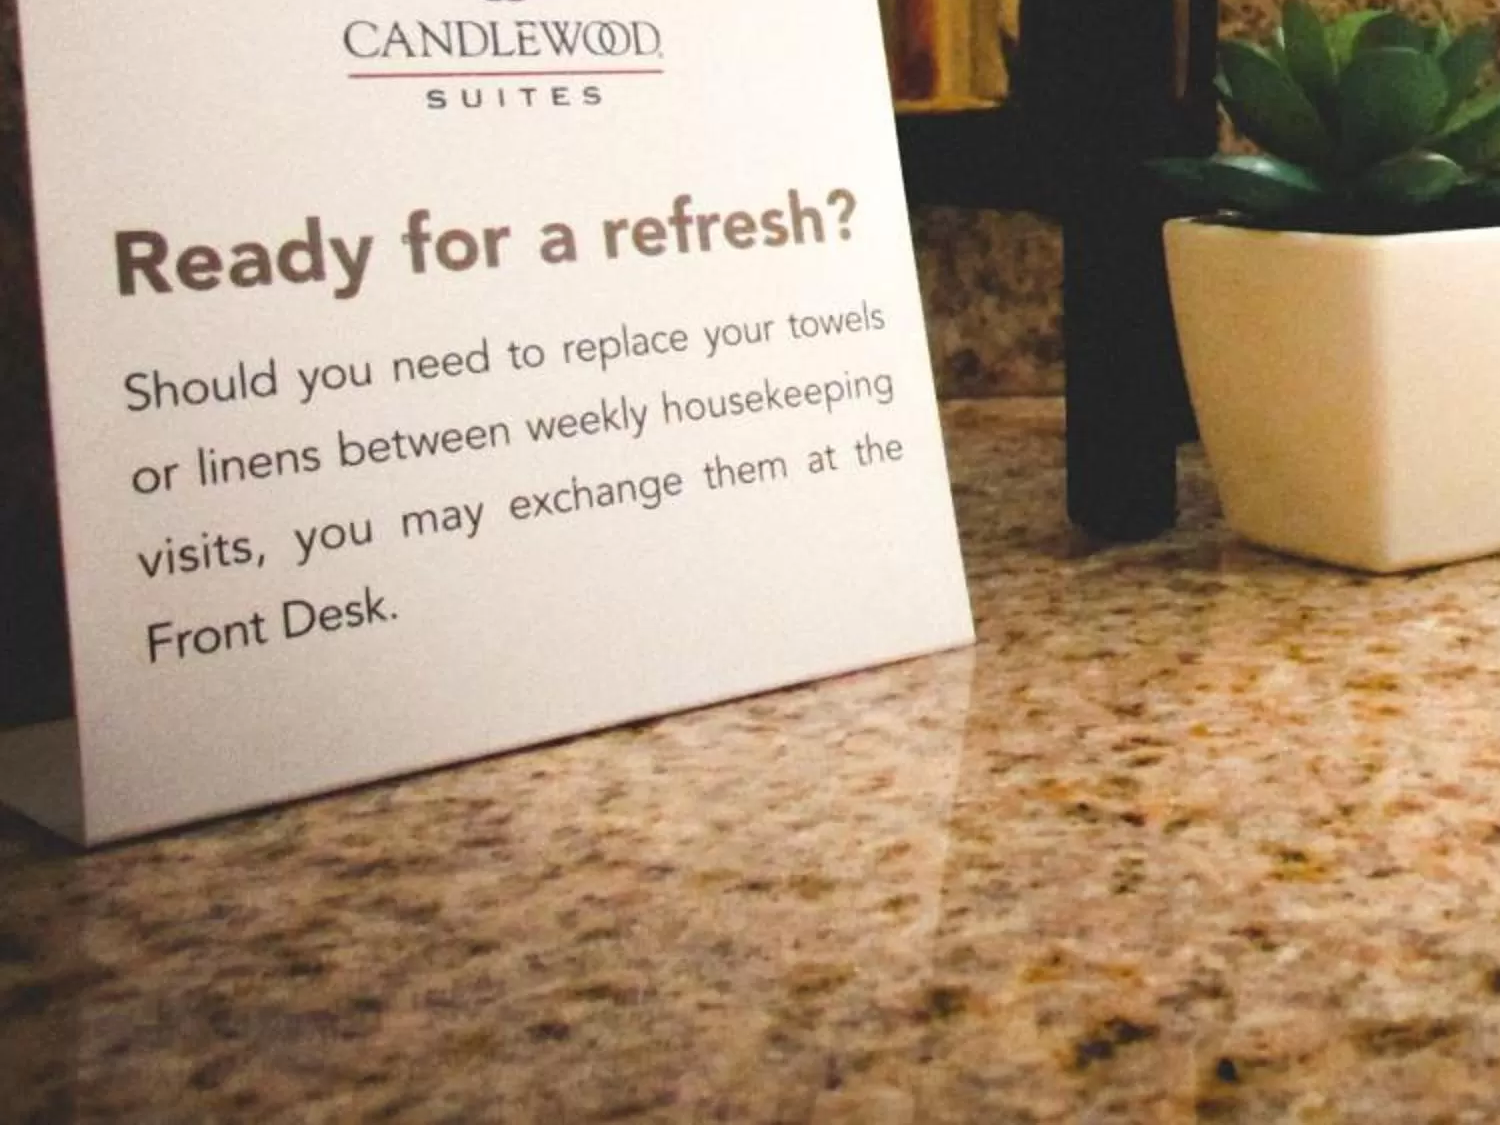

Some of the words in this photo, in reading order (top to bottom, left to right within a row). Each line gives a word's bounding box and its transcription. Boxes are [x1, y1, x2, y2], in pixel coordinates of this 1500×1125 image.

[343, 19, 661, 59] CANDLEWOOD
[426, 86, 603, 110] SUITES
[114, 215, 375, 301] Ready
[401, 209, 512, 275] for
[540, 222, 578, 265] a
[603, 187, 859, 260] refresh?
[124, 357, 278, 412] Should
[297, 364, 373, 405] you
[393, 337, 491, 383] need
[507, 341, 546, 371] to
[563, 322, 689, 372] replace
[704, 315, 774, 359] your
[788, 300, 886, 340] towels
[132, 458, 180, 495] or
[197, 446, 322, 487] linens
[338, 420, 511, 468] between
[525, 395, 649, 443] weekly
[662, 368, 895, 424] housekeeping
[138, 536, 266, 579] visits,
[294, 519, 374, 568] you
[402, 502, 485, 540] may
[509, 471, 684, 521] exchange
[703, 453, 788, 492] them
[807, 445, 839, 475] at
[854, 433, 904, 468] the
[148, 611, 269, 665] Front
[282, 586, 399, 640] Desk.
